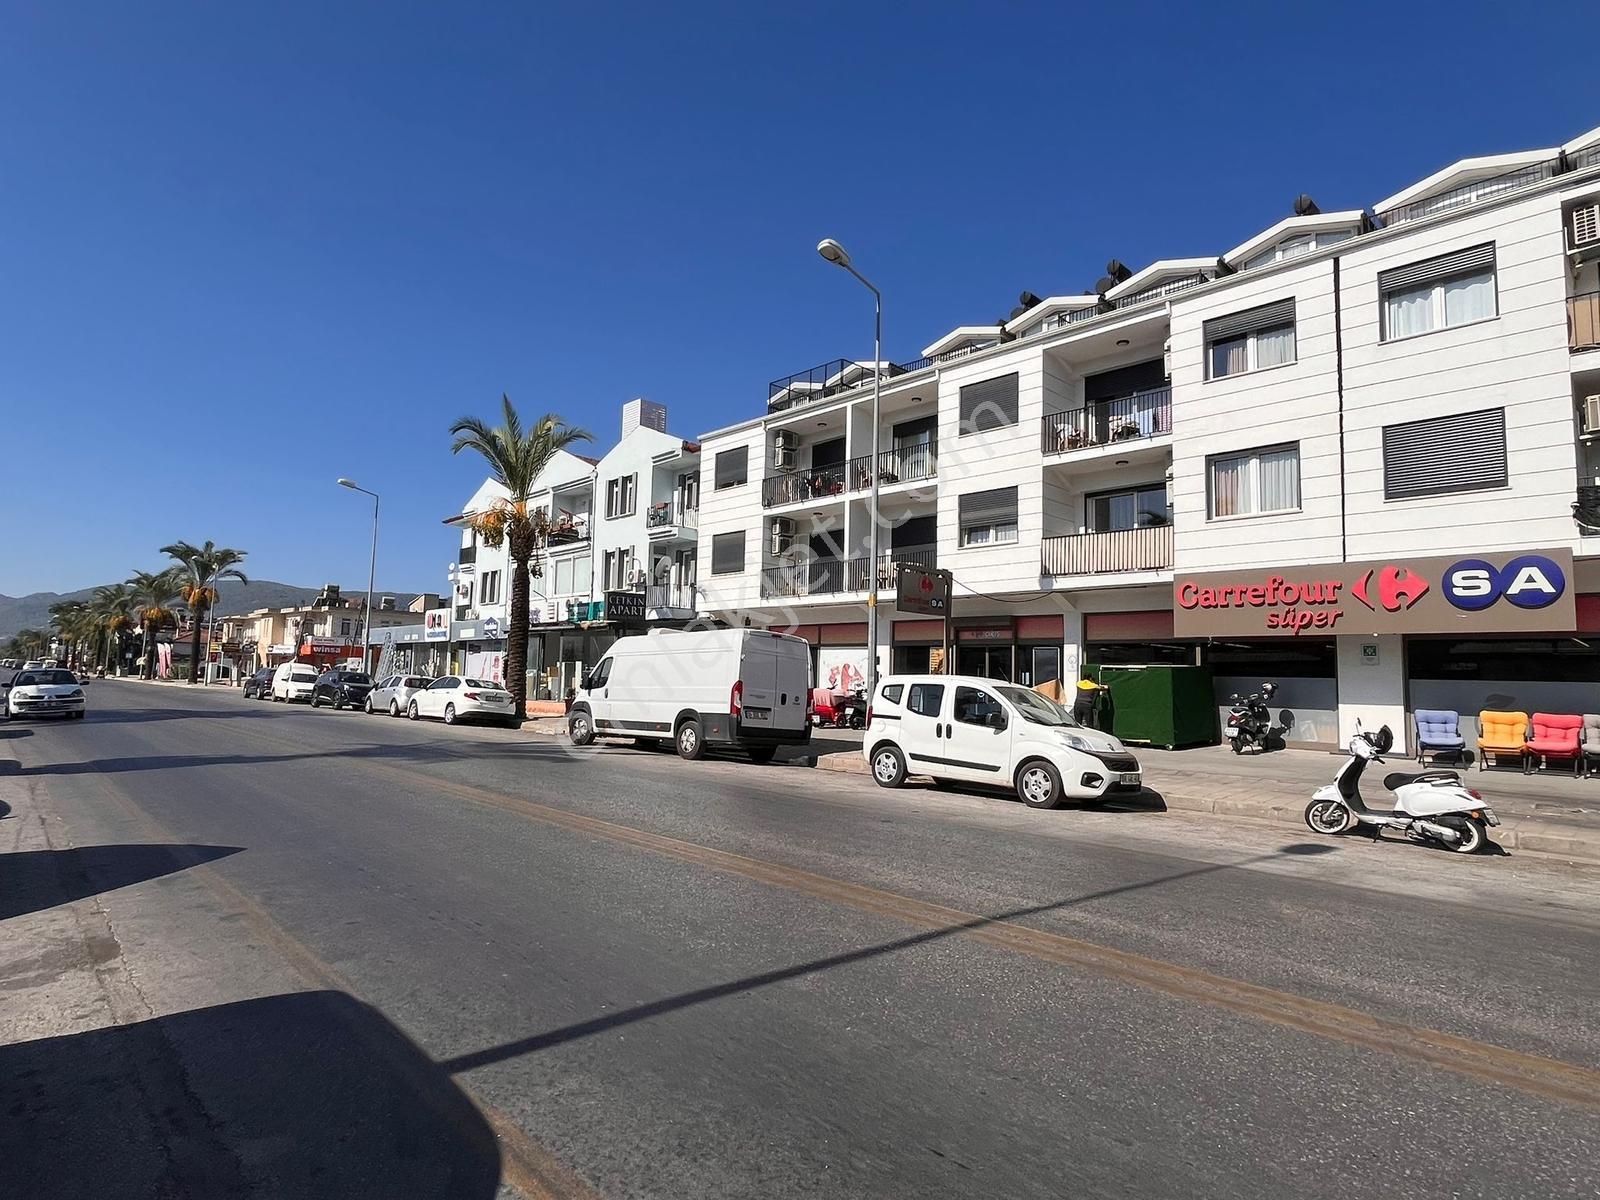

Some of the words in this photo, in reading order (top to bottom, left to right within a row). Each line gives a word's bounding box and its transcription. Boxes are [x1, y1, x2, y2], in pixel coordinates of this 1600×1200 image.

[1177, 576, 1342, 610] Carrefour
[1452, 566, 1557, 596] SA
[609, 606, 645, 616] APART
[1267, 608, 1343, 636] süper
